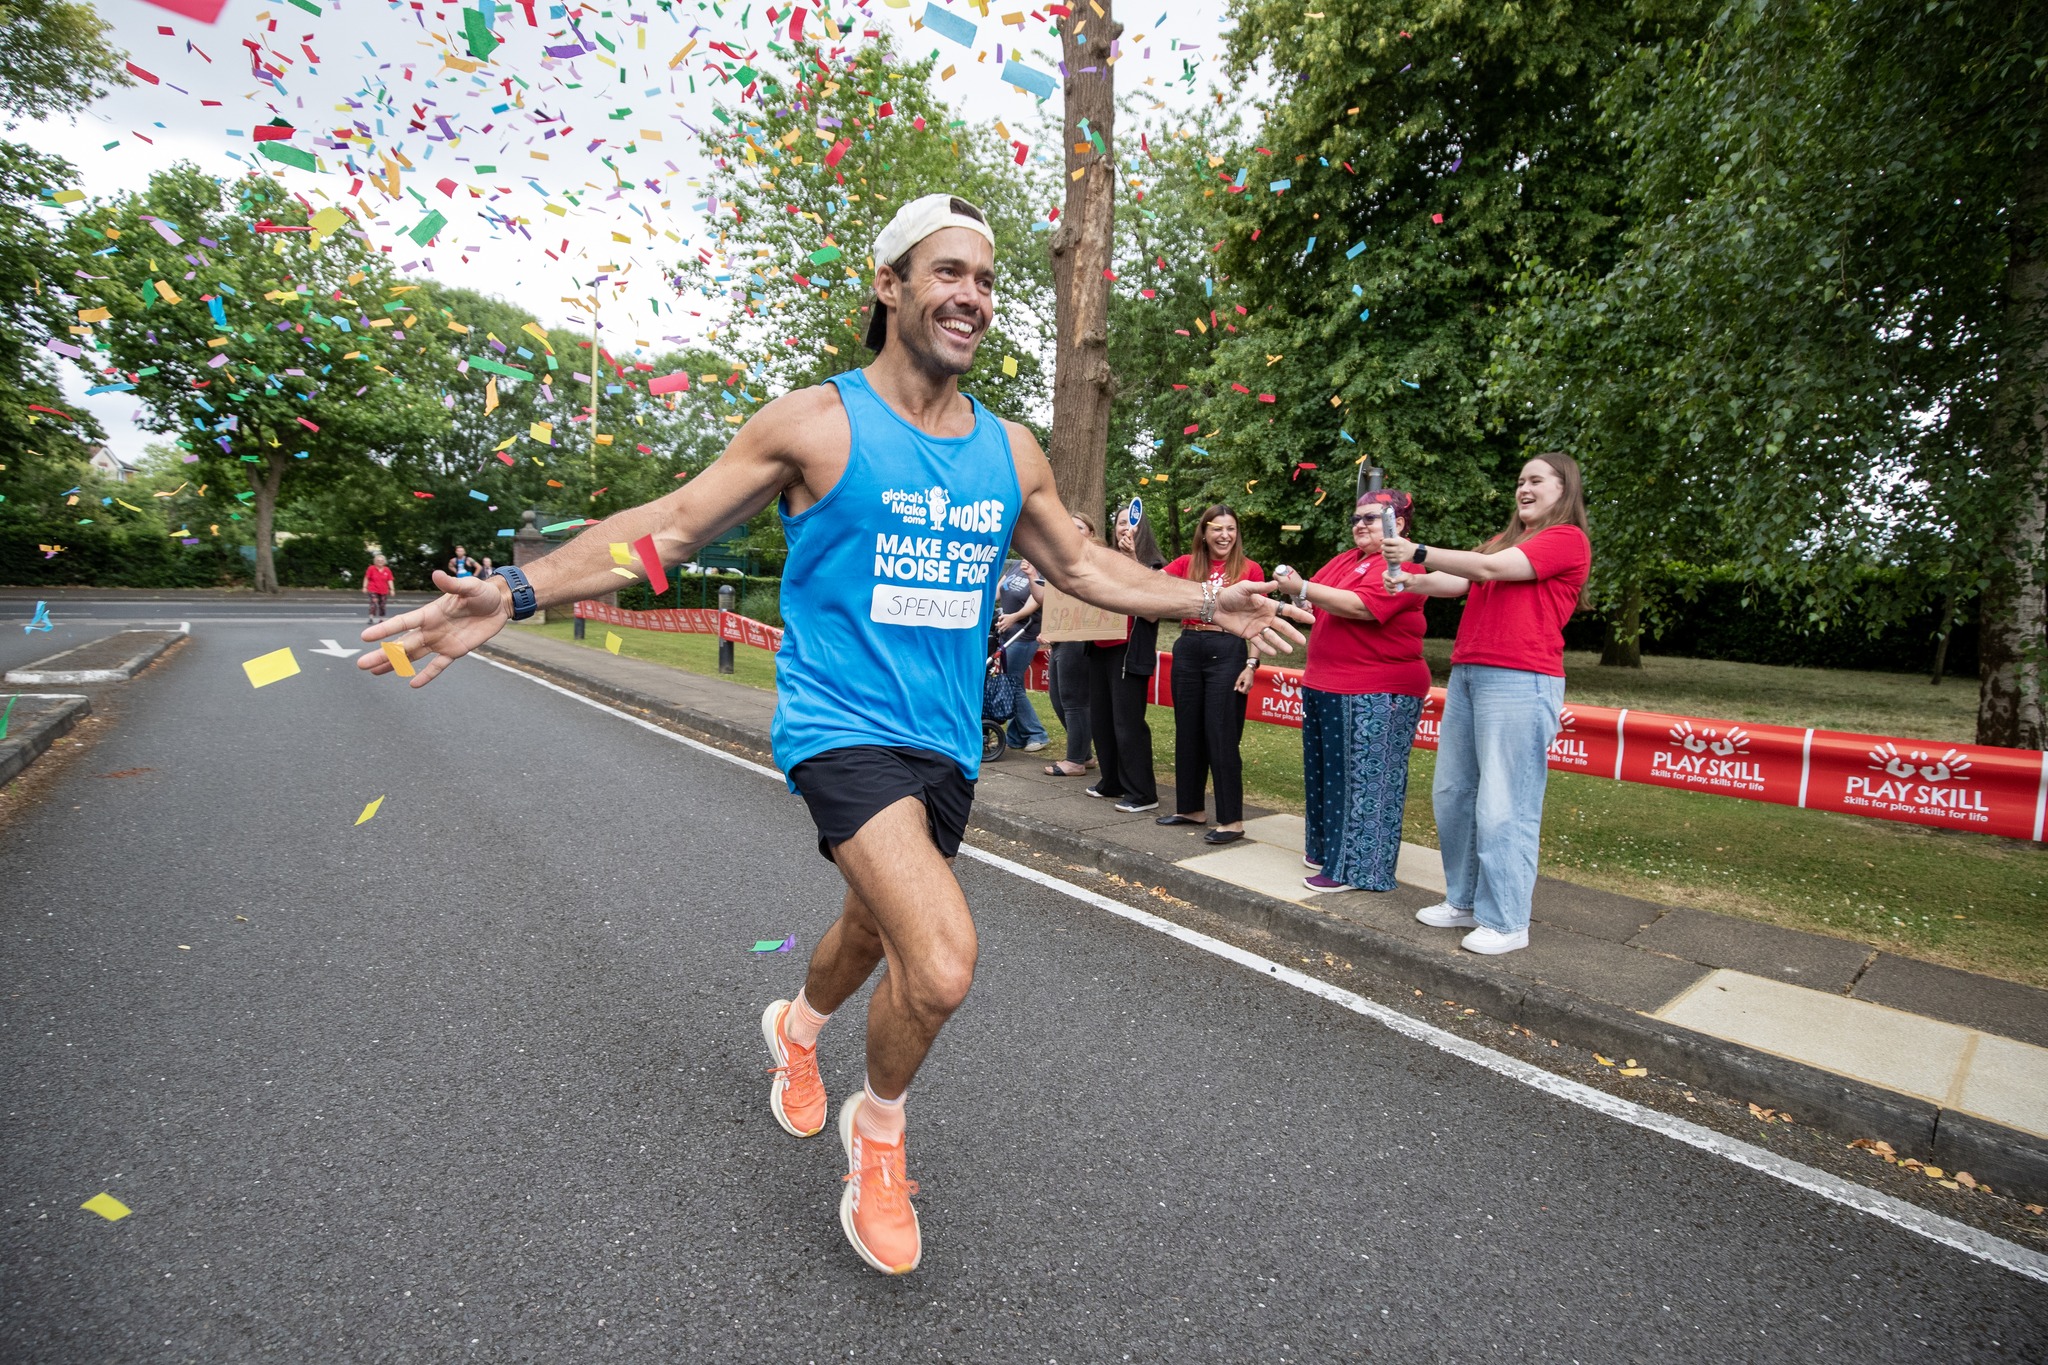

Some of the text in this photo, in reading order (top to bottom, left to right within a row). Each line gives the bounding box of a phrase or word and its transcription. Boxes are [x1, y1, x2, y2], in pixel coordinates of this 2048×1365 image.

[882, 488, 923, 504] global's
[891, 501, 927, 517] Make
[902, 515, 926, 525] some
[948, 500, 1004, 534] NOISE
[876, 533, 999, 563] MAKE SOME
[874, 554, 950, 583] NOISE
[956, 563, 989, 585] FOR
[887, 595, 975, 618] SPENCER
[1262, 696, 1293, 713] PLAY
[1417, 720, 1441, 736] KIL
[1546, 739, 1588, 757] KILL
[1548, 753, 1588, 765] kills for life
[1653, 751, 1765, 782] PLAY SKILL
[1650, 769, 1764, 791] Skills for play, skills for life
[1846, 776, 1989, 811] PLAY SKILL
[1843, 796, 1988, 822] Skills for play, skills for life
